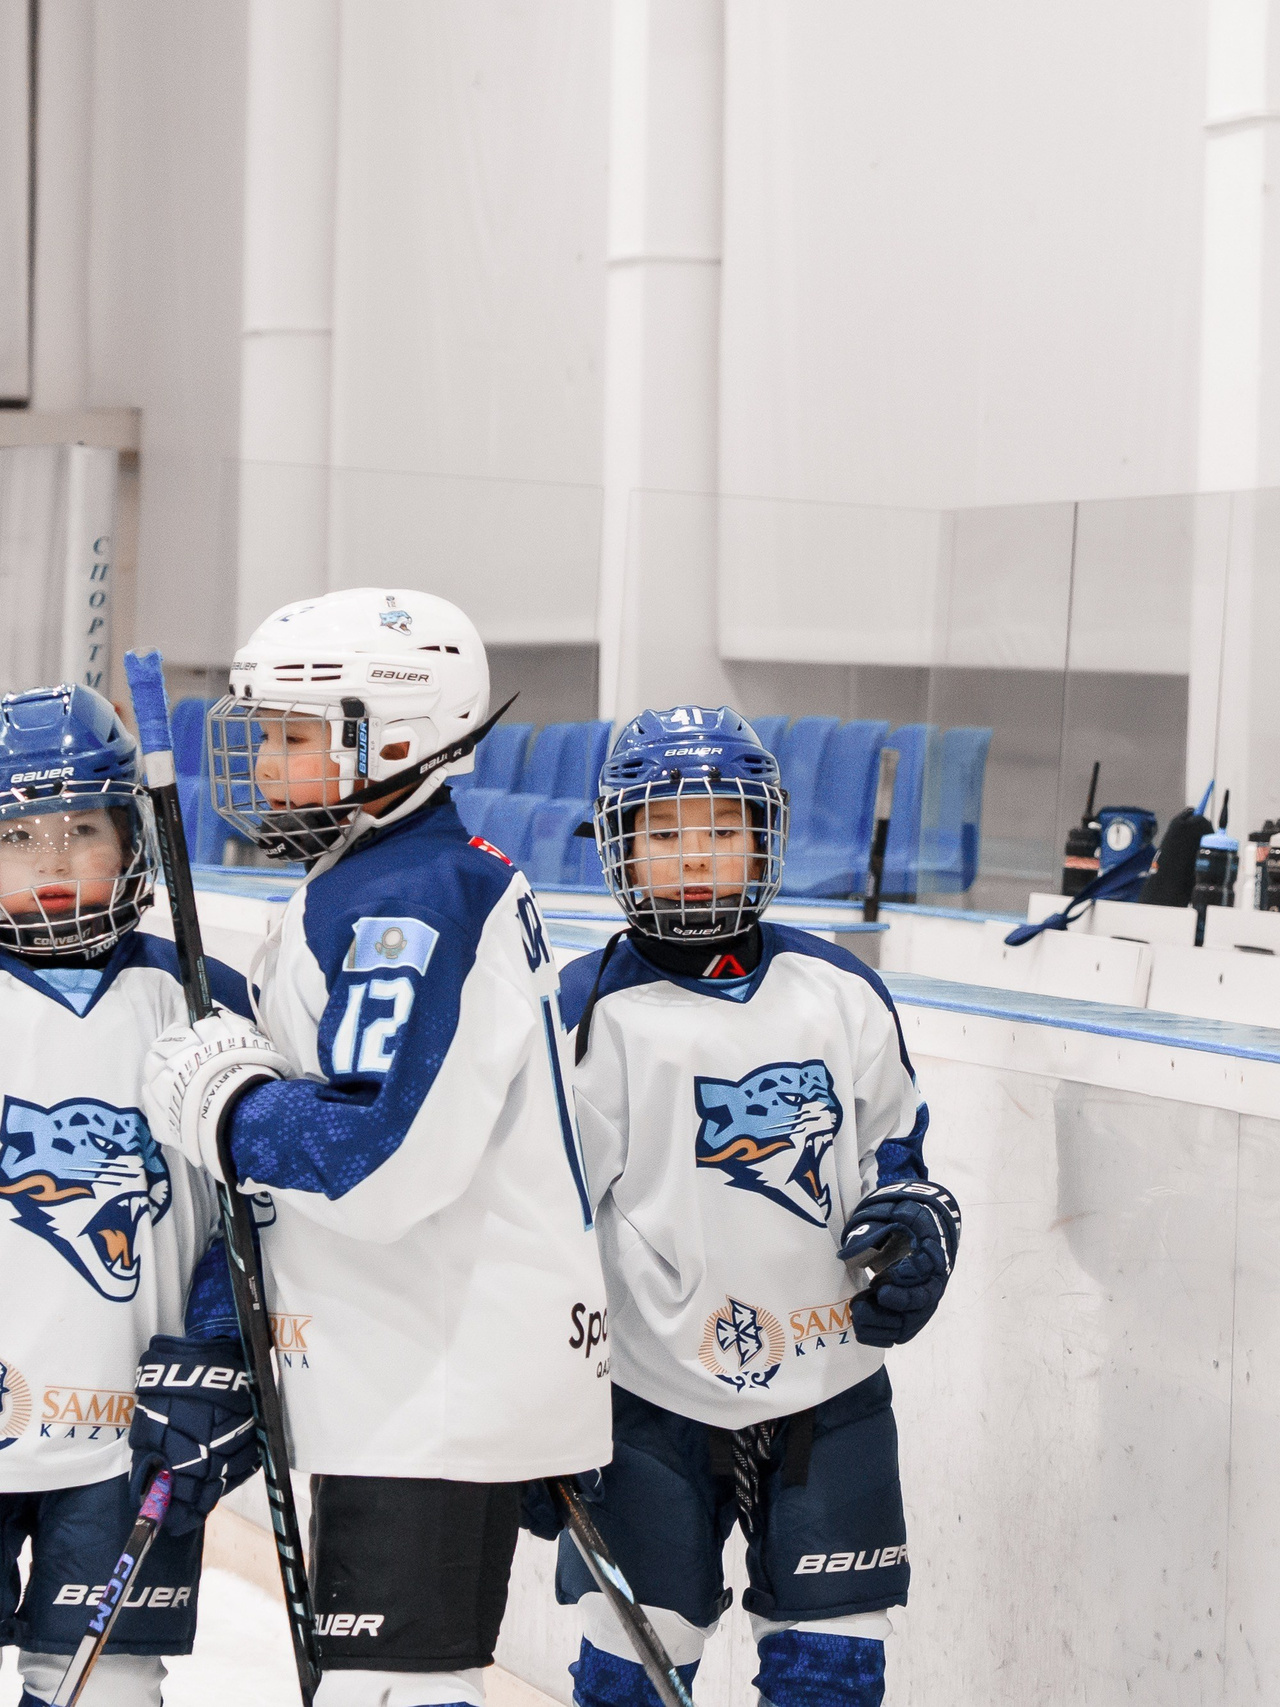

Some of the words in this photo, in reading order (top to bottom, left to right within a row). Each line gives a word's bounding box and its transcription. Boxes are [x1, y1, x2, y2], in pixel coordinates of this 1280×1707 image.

[370, 669, 430, 683] BAUER
[670, 708, 704, 726] 41
[358, 720, 367, 775] BAUER
[664, 747, 723, 757] BAUER
[11, 766, 75, 784] BAUER
[673, 924, 722, 937] BAUER
[331, 976, 416, 1074] 12
[201, 1064, 243, 1120] NURTAZIN
[793, 1544, 909, 1575] BAUER
[88, 1553, 135, 1633] CCM
[312, 1613, 385, 1637] UER
